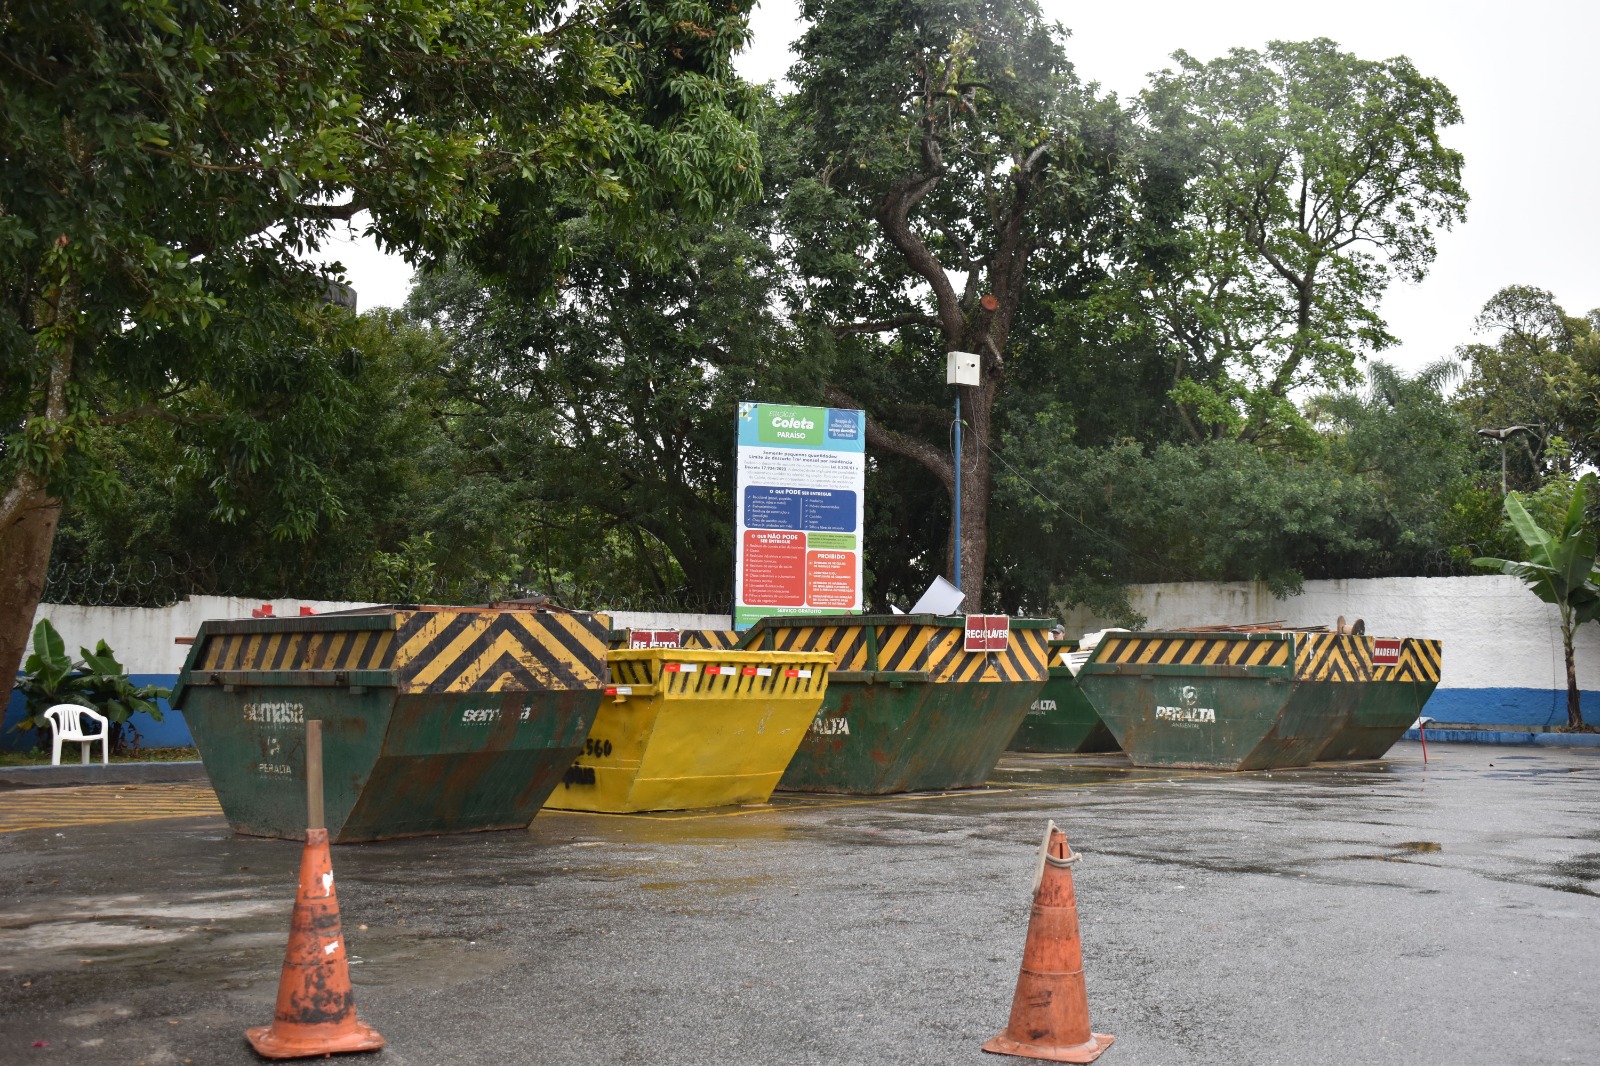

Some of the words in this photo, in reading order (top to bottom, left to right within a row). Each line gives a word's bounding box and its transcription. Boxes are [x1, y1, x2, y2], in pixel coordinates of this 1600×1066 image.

[772, 417, 815, 430] Coleta
[777, 430, 806, 440] PARAÍSO
[785, 488, 802, 496] PODE
[767, 531, 781, 540] NÃO
[777, 607, 798, 615] SERVIÇO
[798, 608, 823, 616] GRATUITO
[966, 628, 1009, 639] RECICLÁVEIS
[633, 641, 677, 649] REJEITO
[1374, 647, 1399, 657] MADEIRA
[1155, 705, 1216, 724] PERALTA
[259, 763, 293, 775] PERALTA
